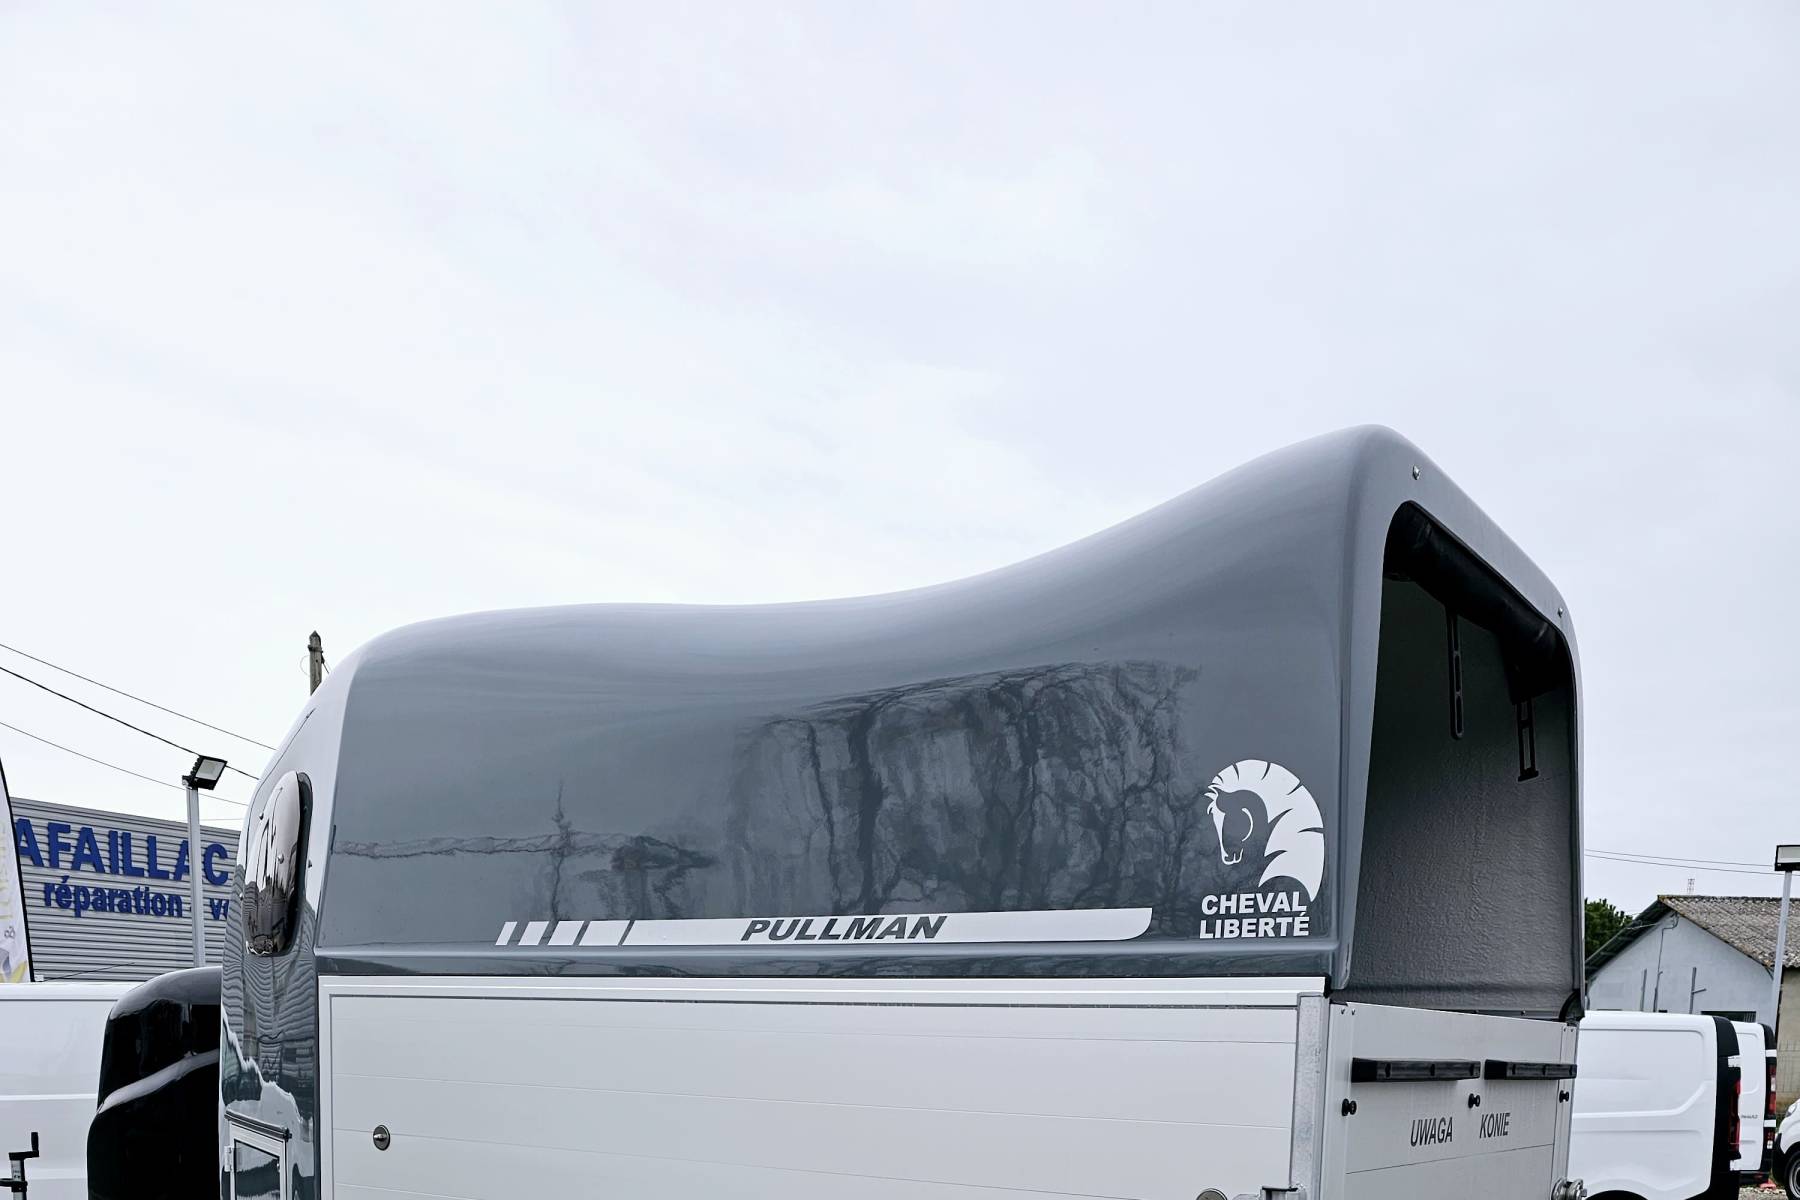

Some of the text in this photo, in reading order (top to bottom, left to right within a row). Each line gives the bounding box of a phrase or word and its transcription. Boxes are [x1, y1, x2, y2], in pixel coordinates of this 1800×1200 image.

[44, 876, 183, 918] réparation
[1201, 891, 1308, 915] CHEVAL
[741, 915, 947, 941] PULLMAN
[1199, 912, 1310, 939] LIBERTÉ
[1410, 1112, 1511, 1147] UWAGA KONIE
